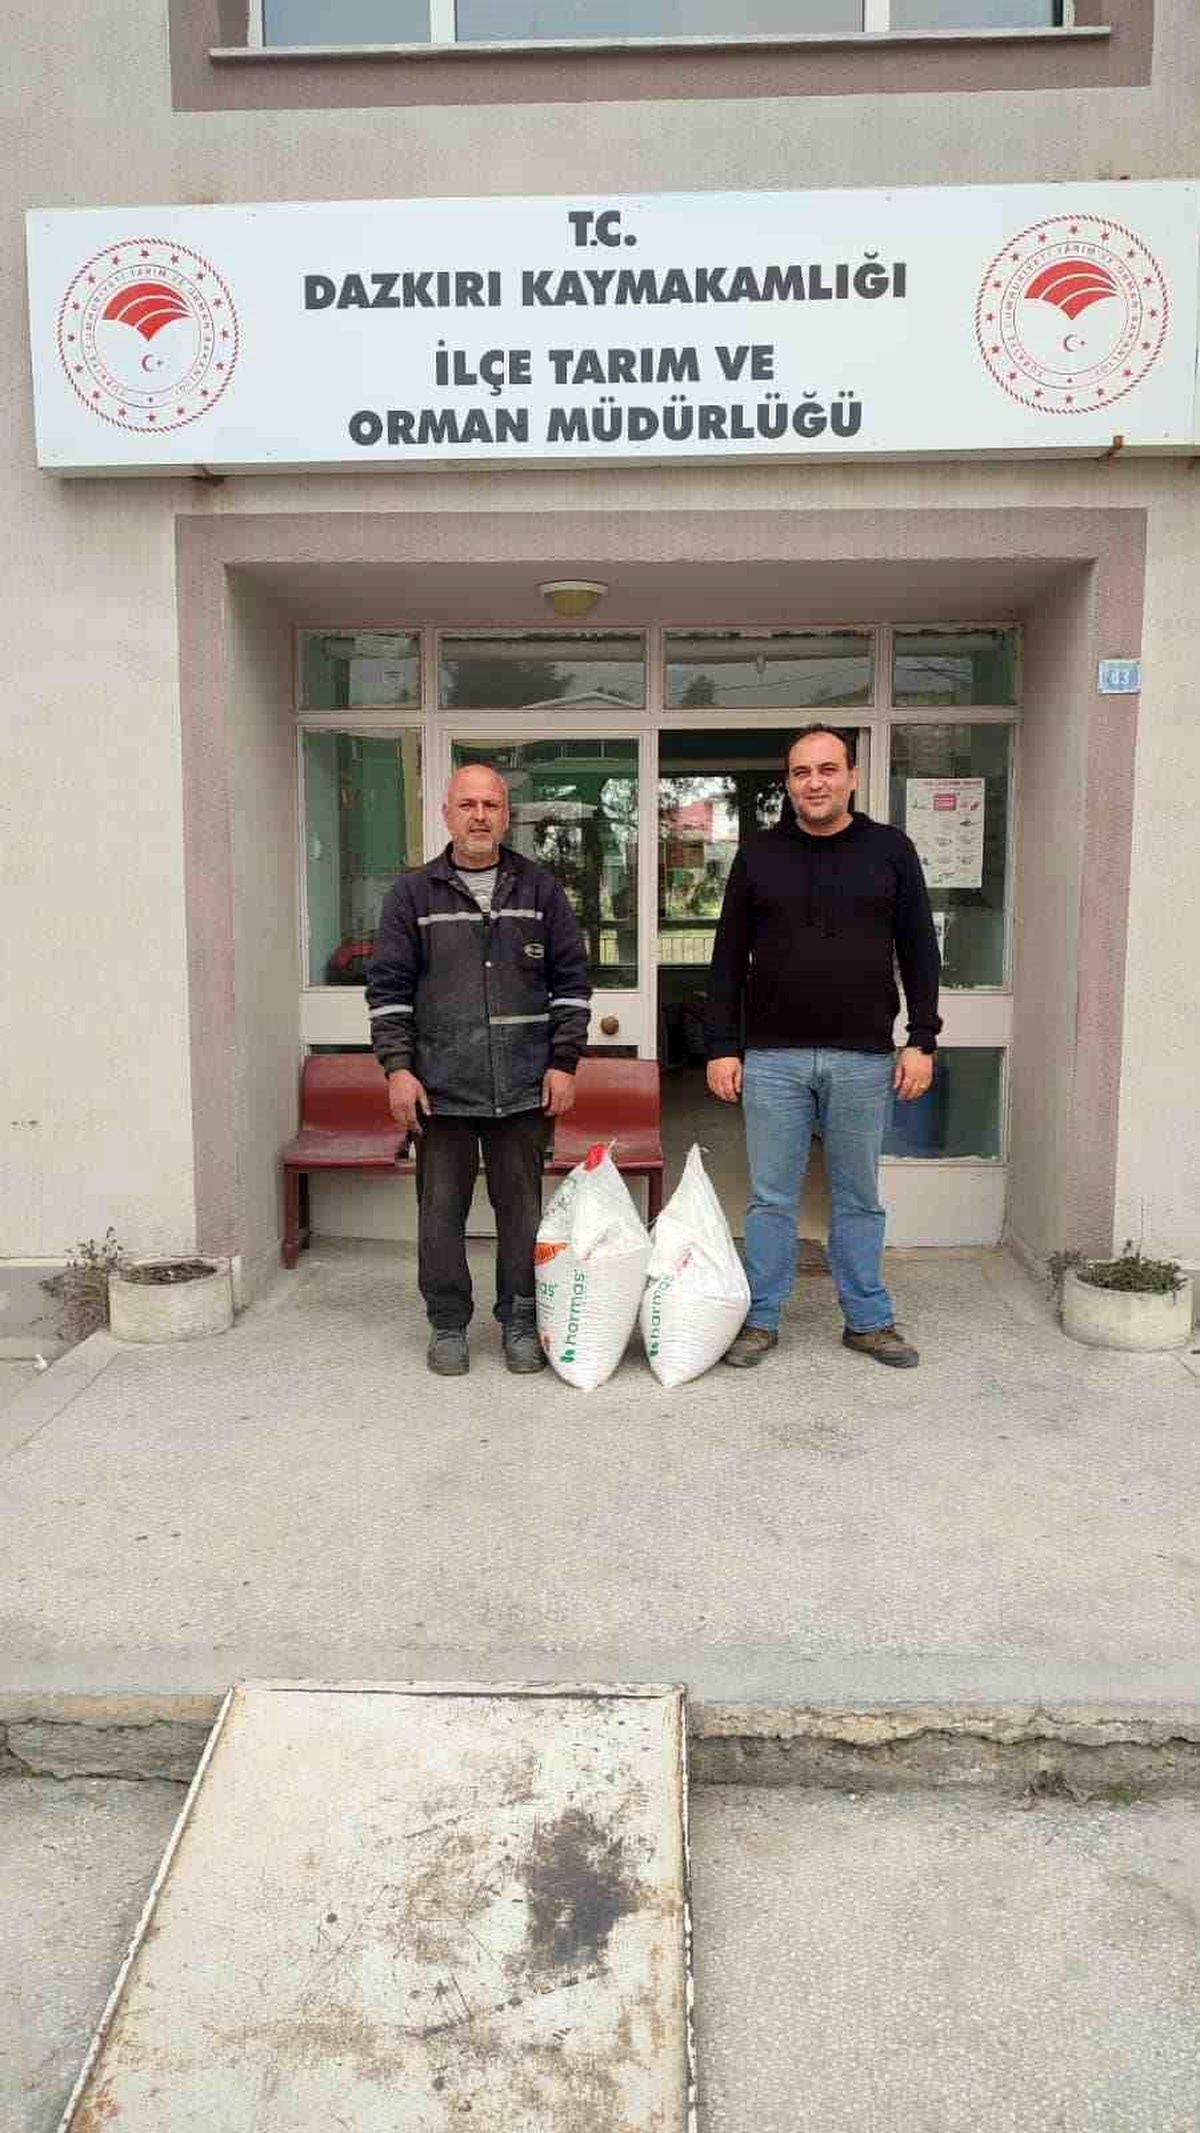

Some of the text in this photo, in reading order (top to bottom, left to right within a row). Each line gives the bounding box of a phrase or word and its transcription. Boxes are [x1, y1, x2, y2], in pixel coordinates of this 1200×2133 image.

[568, 211, 637, 248] T.C.
[304, 251, 907, 310] DAZKIRI KAYMAKAMLIĞI
[435, 339, 774, 397] İLÇE TARIM VE
[348, 390, 862, 446] ORMAN MÜDÜRLÜĞÜ
